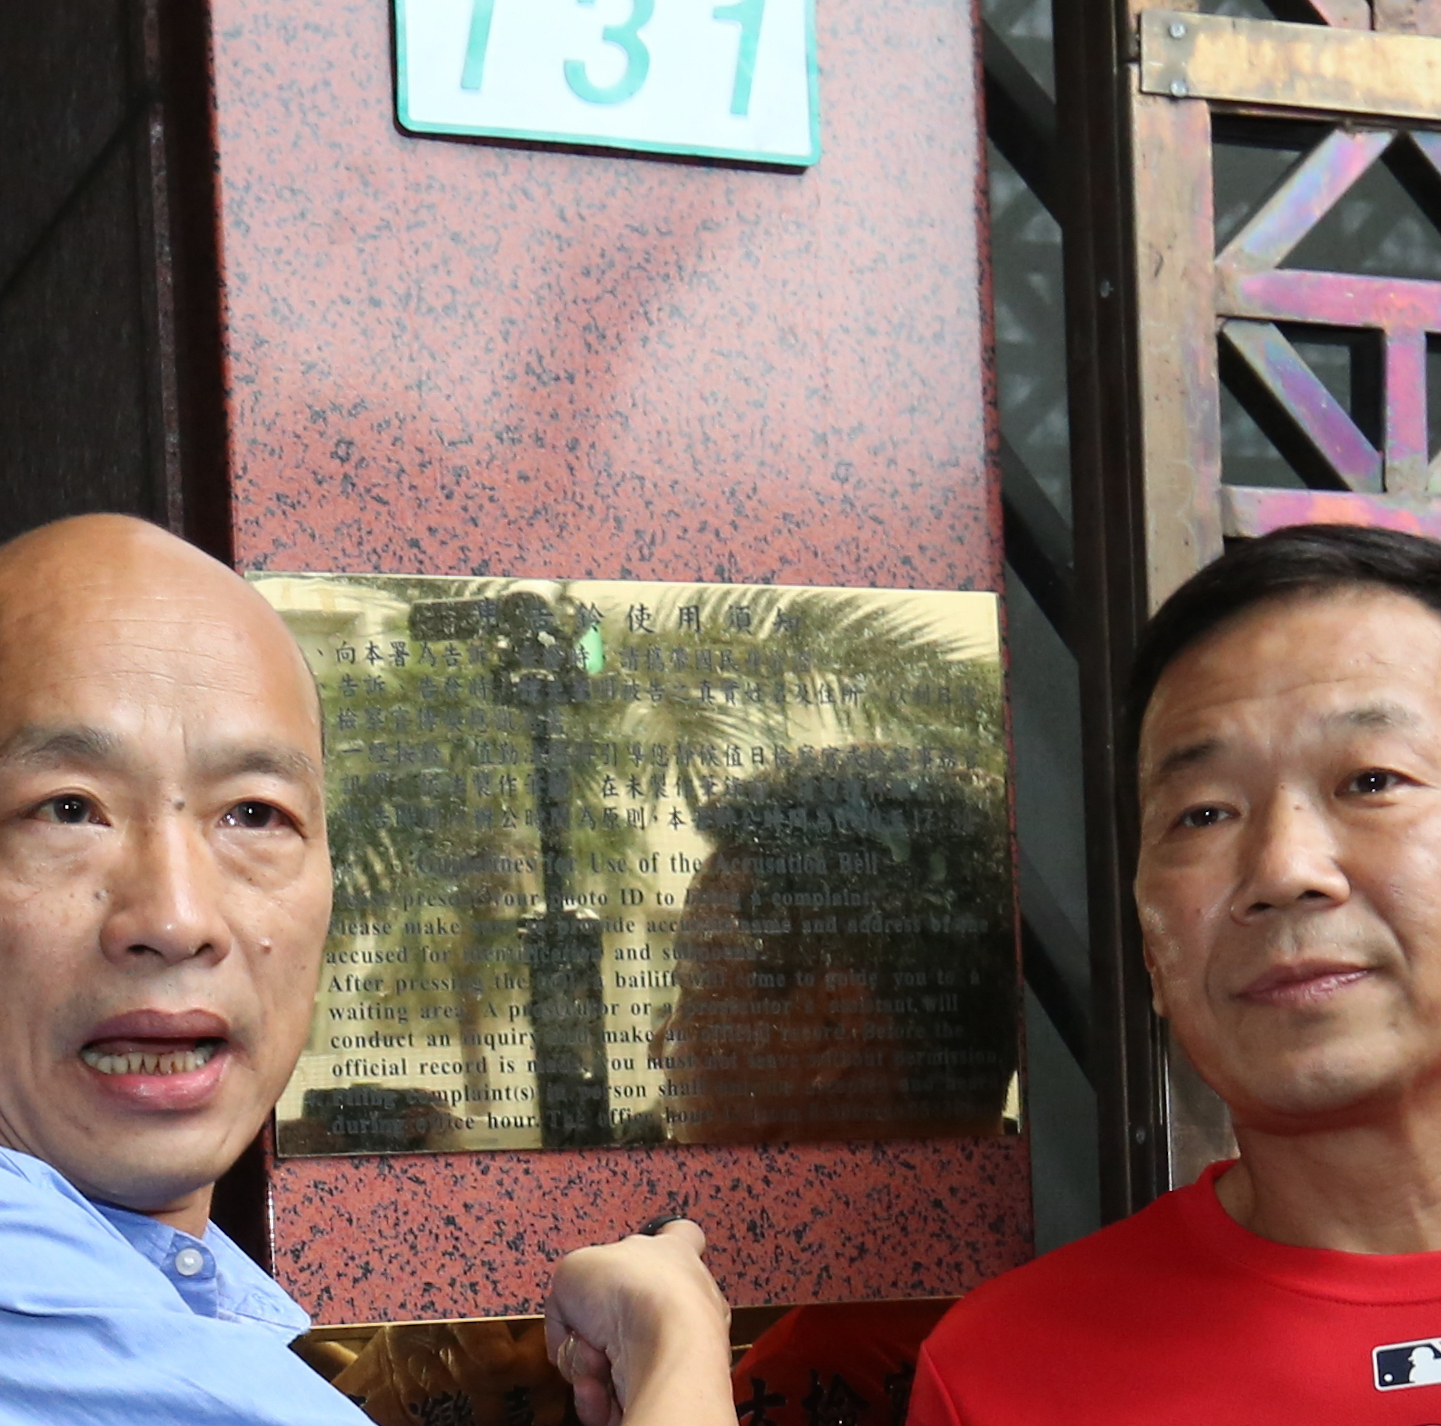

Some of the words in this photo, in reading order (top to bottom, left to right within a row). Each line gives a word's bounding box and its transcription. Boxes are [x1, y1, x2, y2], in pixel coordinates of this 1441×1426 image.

[590, 852, 627, 873] Use
[638, 851, 660, 873] of
[670, 851, 703, 873] the
[839, 853, 879, 875] Bell
[620, 889, 645, 907] ID
[656, 890, 676, 907] to
[404, 918, 460, 936] make
[326, 946, 408, 965] accused
[422, 945, 449, 963] for
[614, 943, 651, 961] and
[327, 974, 385, 993] After
[395, 975, 483, 995] pressing
[494, 973, 527, 990] the
[614, 970, 676, 989] bailiff
[329, 1003, 408, 1024] waiting
[631, 1003, 653, 1017] or
[923, 994, 959, 1012] will
[330, 1031, 415, 1049] conduct
[427, 1034, 452, 1048] an
[601, 1027, 654, 1045] make
[332, 1058, 408, 1078] official
[419, 1057, 488, 1076] record
[499, 1055, 516, 1072] is
[646, 1054, 696, 1071] must
[410, 1083, 536, 1106] complaint(s)
[332, 1114, 408, 1136] during
